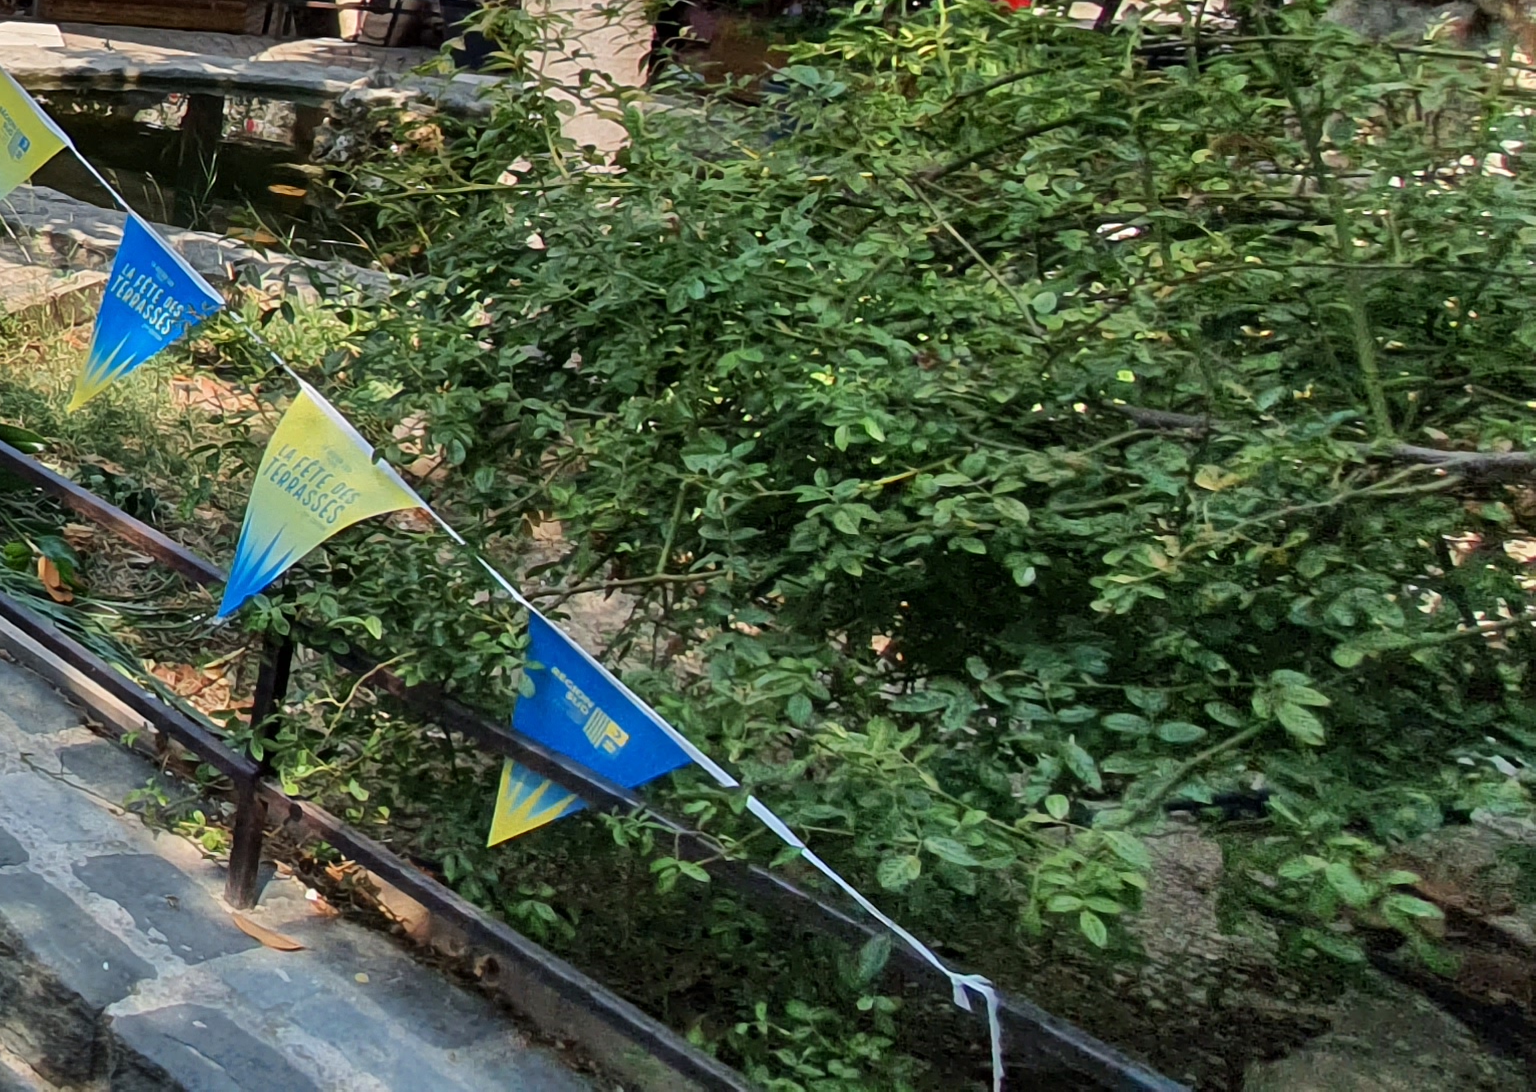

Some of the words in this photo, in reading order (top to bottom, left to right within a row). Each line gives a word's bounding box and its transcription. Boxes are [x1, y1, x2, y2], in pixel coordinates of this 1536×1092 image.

[110, 274, 175, 335] TERRASSES
[121, 263, 136, 279] LA
[163, 296, 184, 317] DES
[263, 457, 346, 524] TERRASSES
[278, 444, 296, 461] LA
[331, 482, 361, 505] DES
